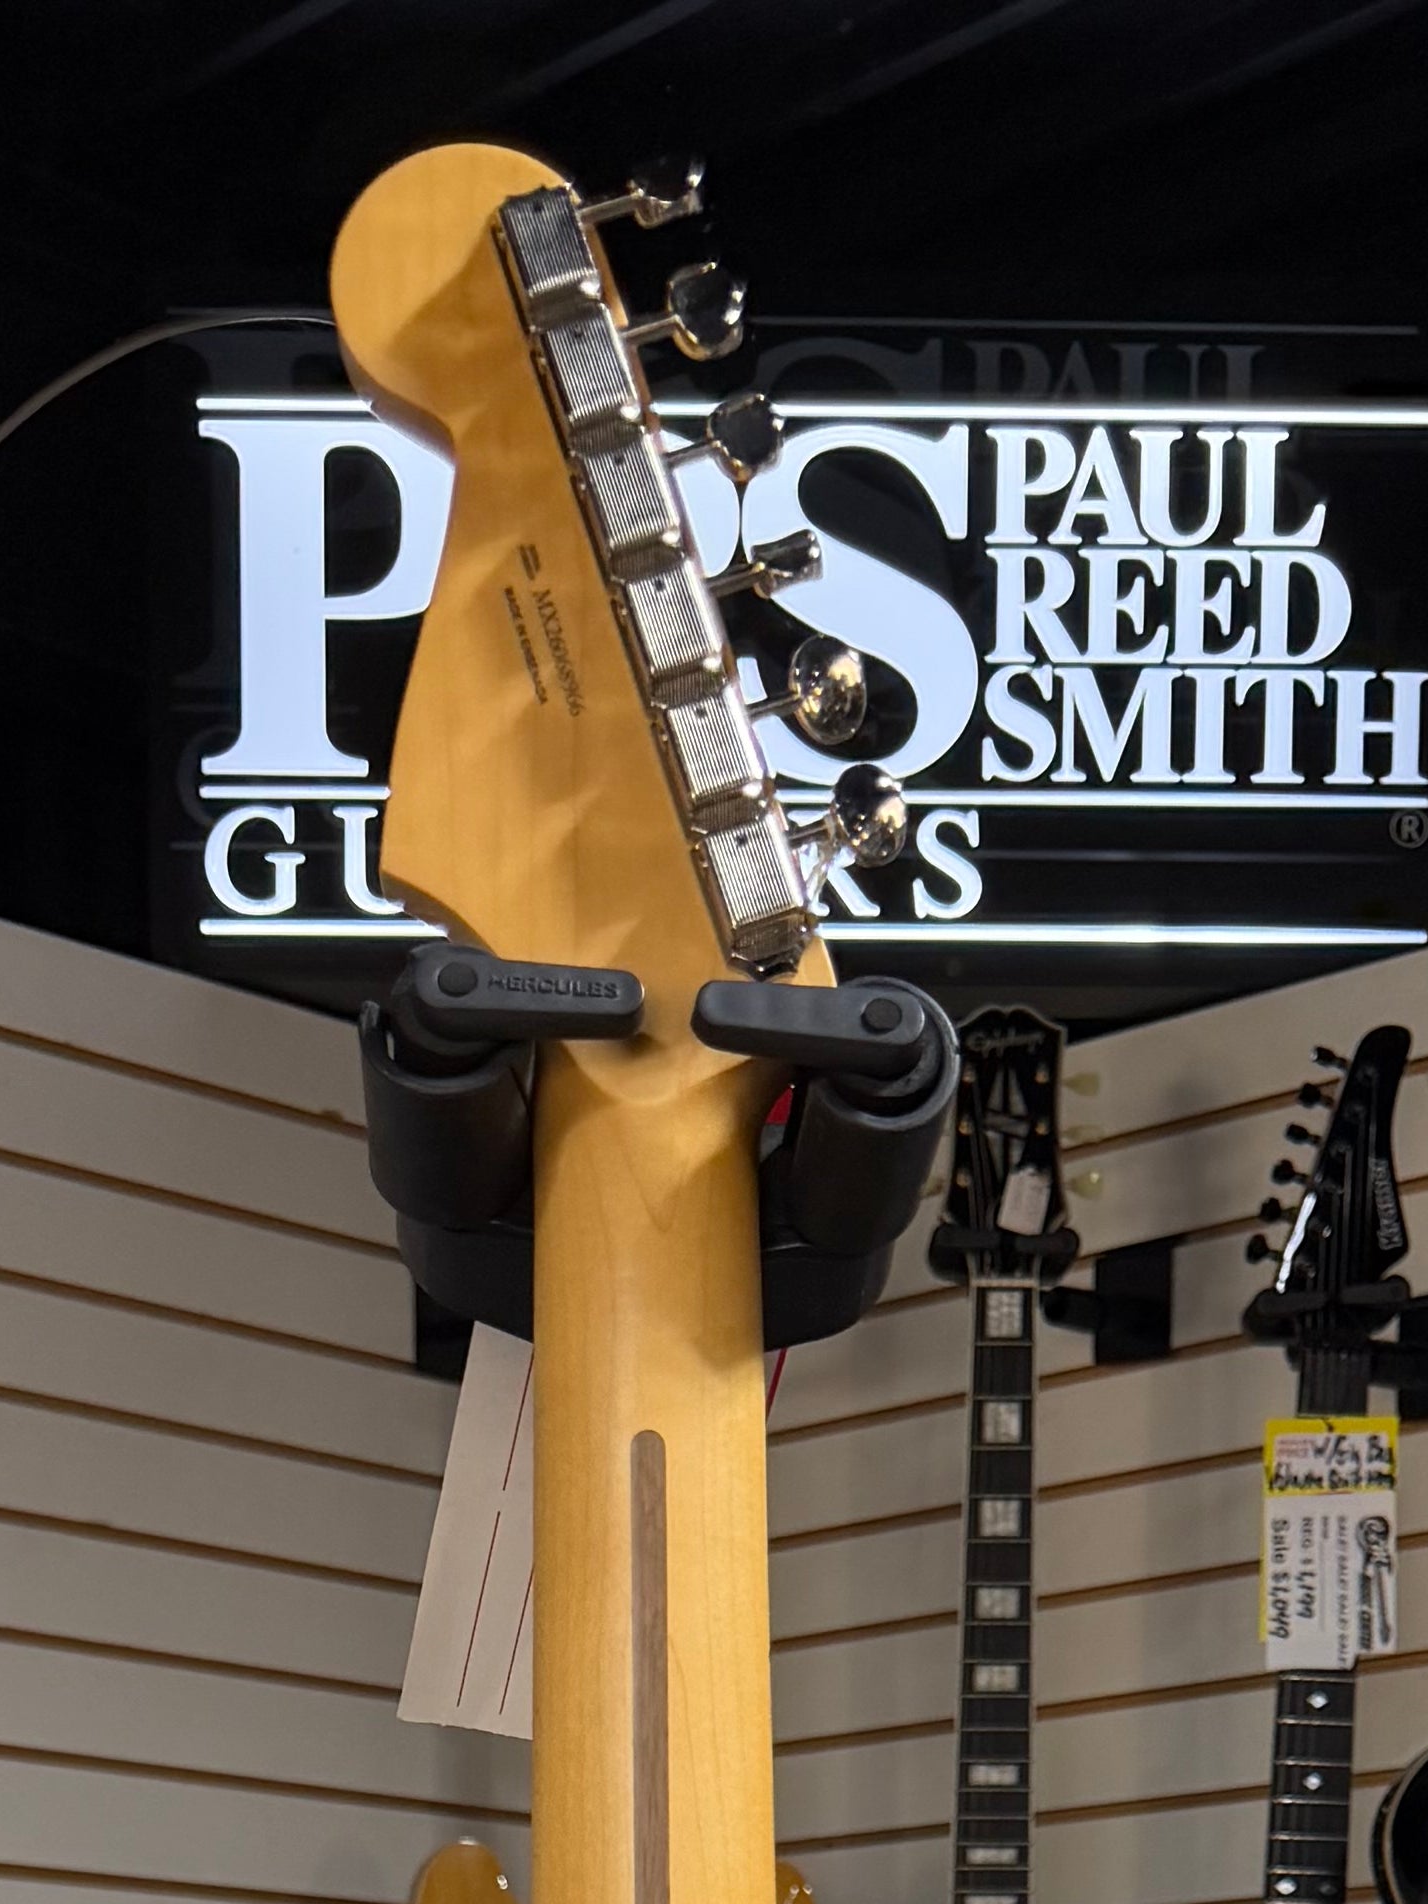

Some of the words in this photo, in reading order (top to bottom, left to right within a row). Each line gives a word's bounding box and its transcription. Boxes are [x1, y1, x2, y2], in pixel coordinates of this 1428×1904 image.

[988, 428, 1329, 547] PAUL
[986, 549, 1353, 666] REED
[486, 971, 620, 1001] HERCULES
